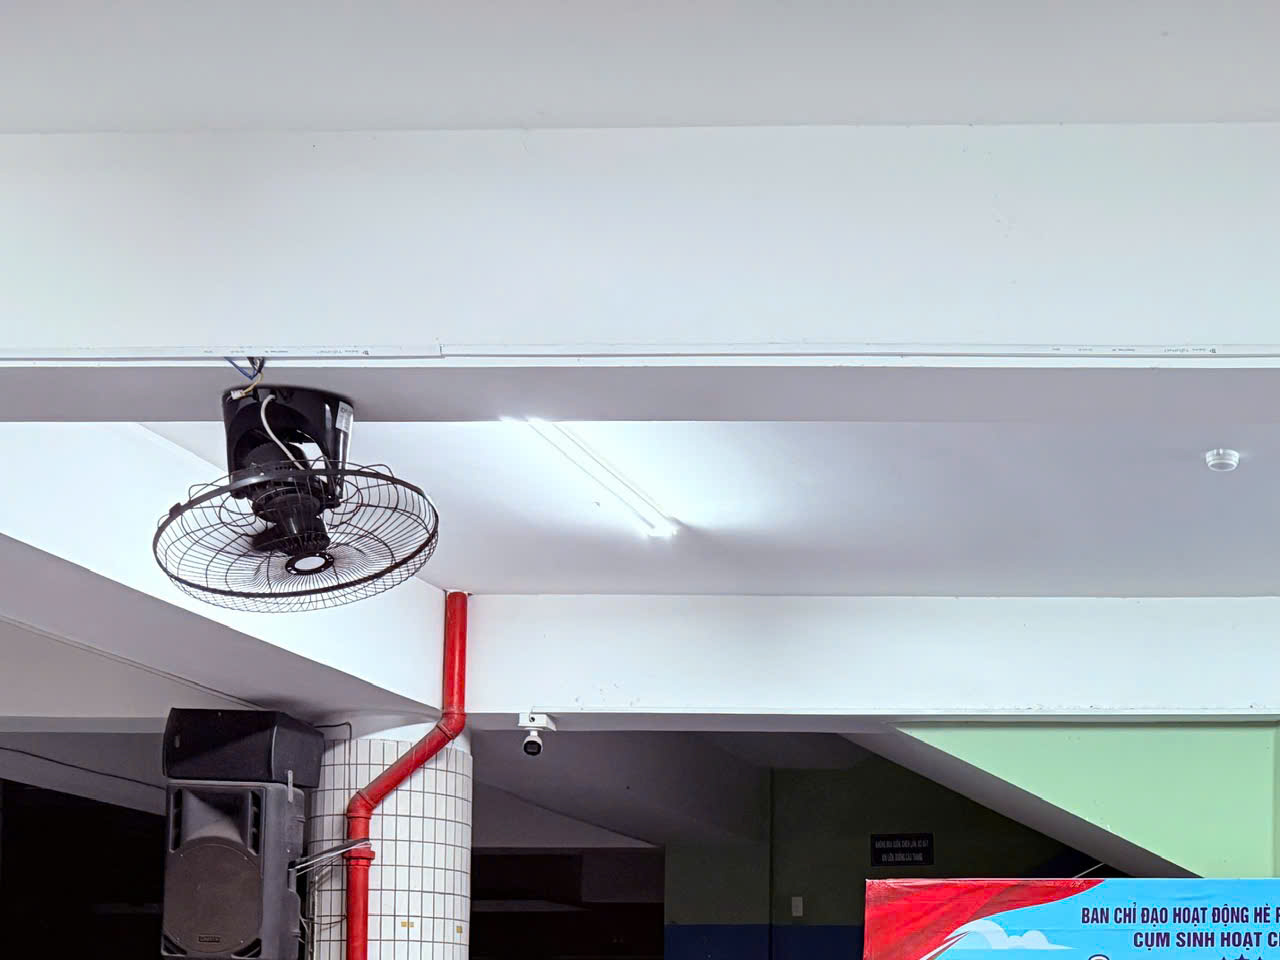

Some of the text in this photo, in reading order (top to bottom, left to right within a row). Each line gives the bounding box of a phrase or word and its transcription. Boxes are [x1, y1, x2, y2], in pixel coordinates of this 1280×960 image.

[1081, 907, 1109, 924] BAN
[1114, 902, 1137, 924] CHỈ
[1141, 907, 1168, 927] ĐẠO
[1173, 907, 1207, 927] HOẠT
[1211, 904, 1249, 927] ĐỘNG
[1254, 903, 1271, 924] HÈ
[1133, 932, 1170, 951] CỤM
[1176, 931, 1215, 948] SINH
[1220, 932, 1262, 951] HOẠT
